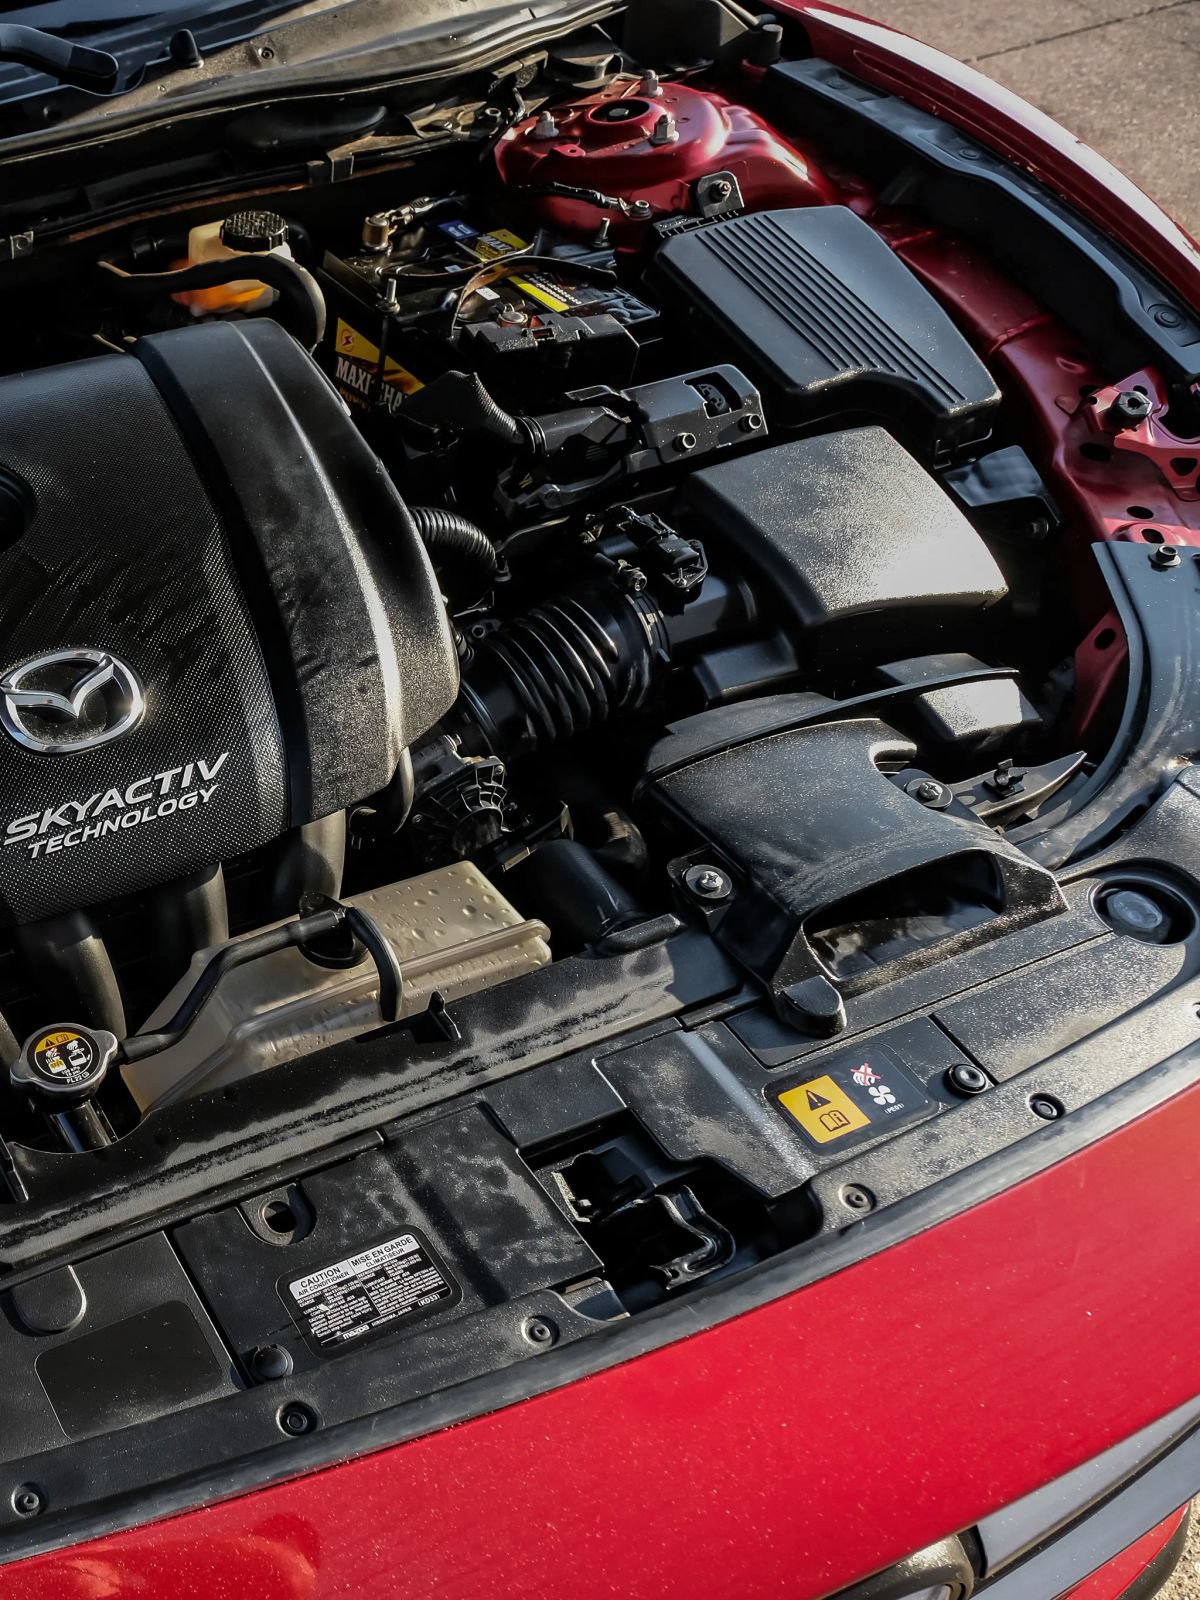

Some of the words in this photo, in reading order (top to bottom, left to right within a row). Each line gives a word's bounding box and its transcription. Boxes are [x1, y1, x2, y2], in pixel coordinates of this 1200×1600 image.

[335, 356, 372, 396] MAXI
[3, 752, 229, 845] SKYACTIV
[27, 784, 219, 859] TECHNOLOGY
[351, 1253, 373, 1267] MISE
[371, 1248, 385, 1258] EN
[383, 1237, 413, 1253] GARDE
[366, 1248, 405, 1268] CLIMATISEUR
[300, 1266, 342, 1289] CAUTION
[309, 1272, 350, 1292] CONDITIONER
[342, 1324, 370, 1340] mazda
